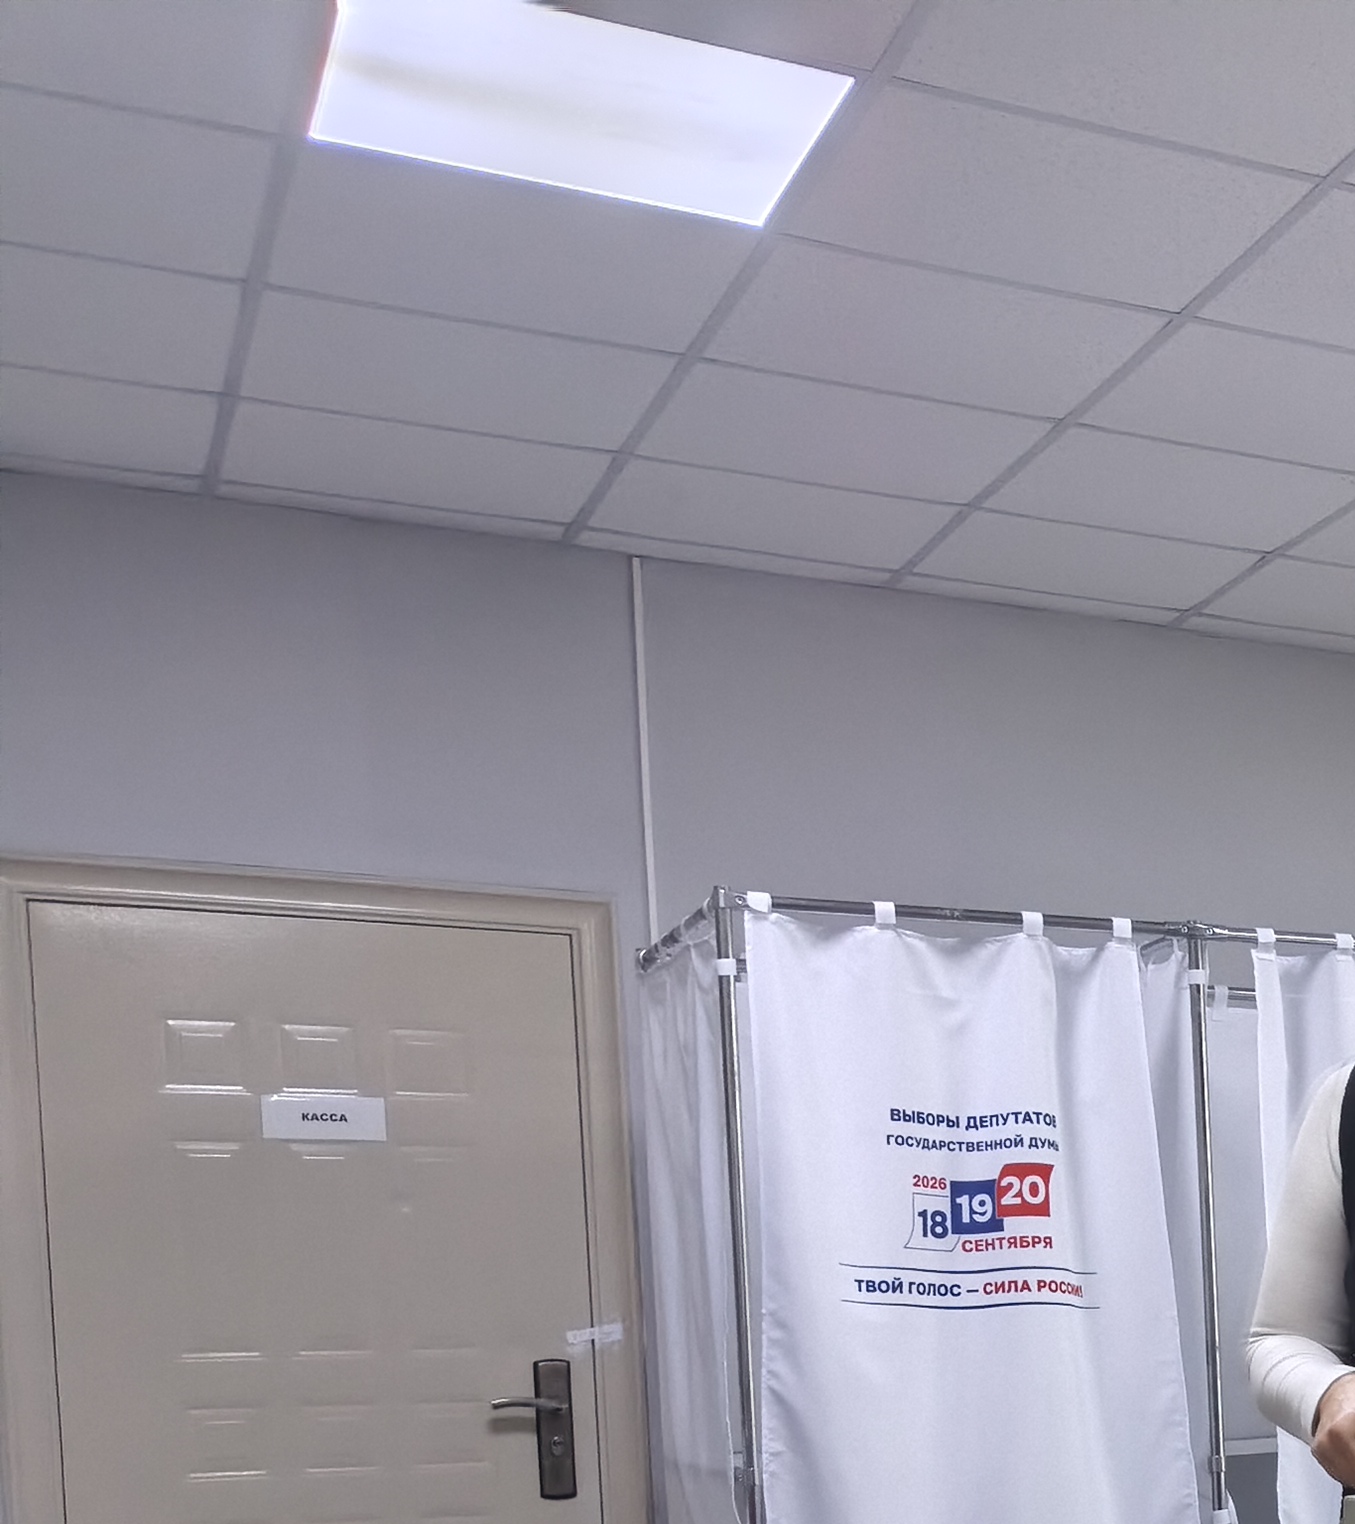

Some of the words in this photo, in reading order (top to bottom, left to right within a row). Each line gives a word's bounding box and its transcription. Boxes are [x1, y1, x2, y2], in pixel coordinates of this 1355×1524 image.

[301, 1112, 348, 1122] КАССА
[889, 1108, 960, 1128] ВЫБОРЫ
[886, 1134, 1024, 1152] ГОСУДАРСТВЕННОЙ
[1028, 1137, 1060, 1152] ДУМ
[912, 1174, 947, 1190] 2026
[917, 1209, 949, 1239] 18
[955, 1193, 993, 1223] 19
[1000, 1175, 1046, 1205] 20
[961, 1235, 1053, 1253] СЕНТЯБРЯ
[854, 1277, 903, 1295] ТВОЙ
[908, 1281, 962, 1297] ГОЛОС
[982, 1279, 1032, 1295] СИЛА
